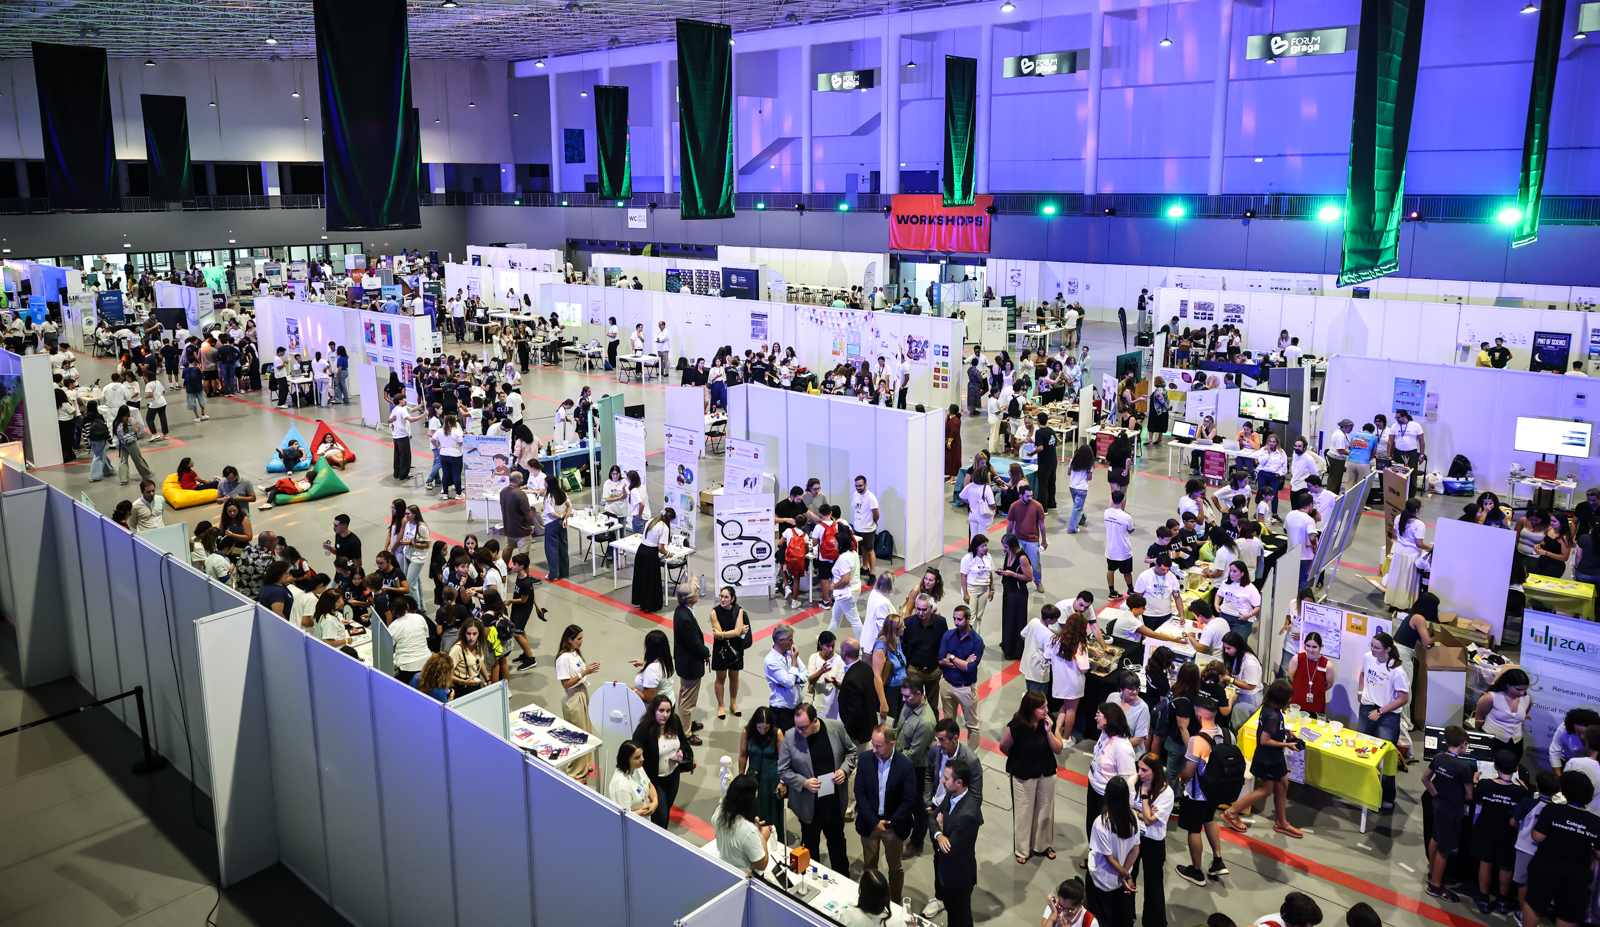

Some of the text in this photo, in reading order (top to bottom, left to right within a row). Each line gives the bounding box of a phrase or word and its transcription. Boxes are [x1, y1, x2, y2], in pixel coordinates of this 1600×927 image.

[1290, 36, 1320, 46] FORUM
[1290, 44, 1320, 54] Braga
[896, 215, 984, 226] WORKSHOPS
[1552, 685, 1586, 698] Research
[1532, 702, 1557, 713] Clinical
[1566, 819, 1587, 830] Colégio
